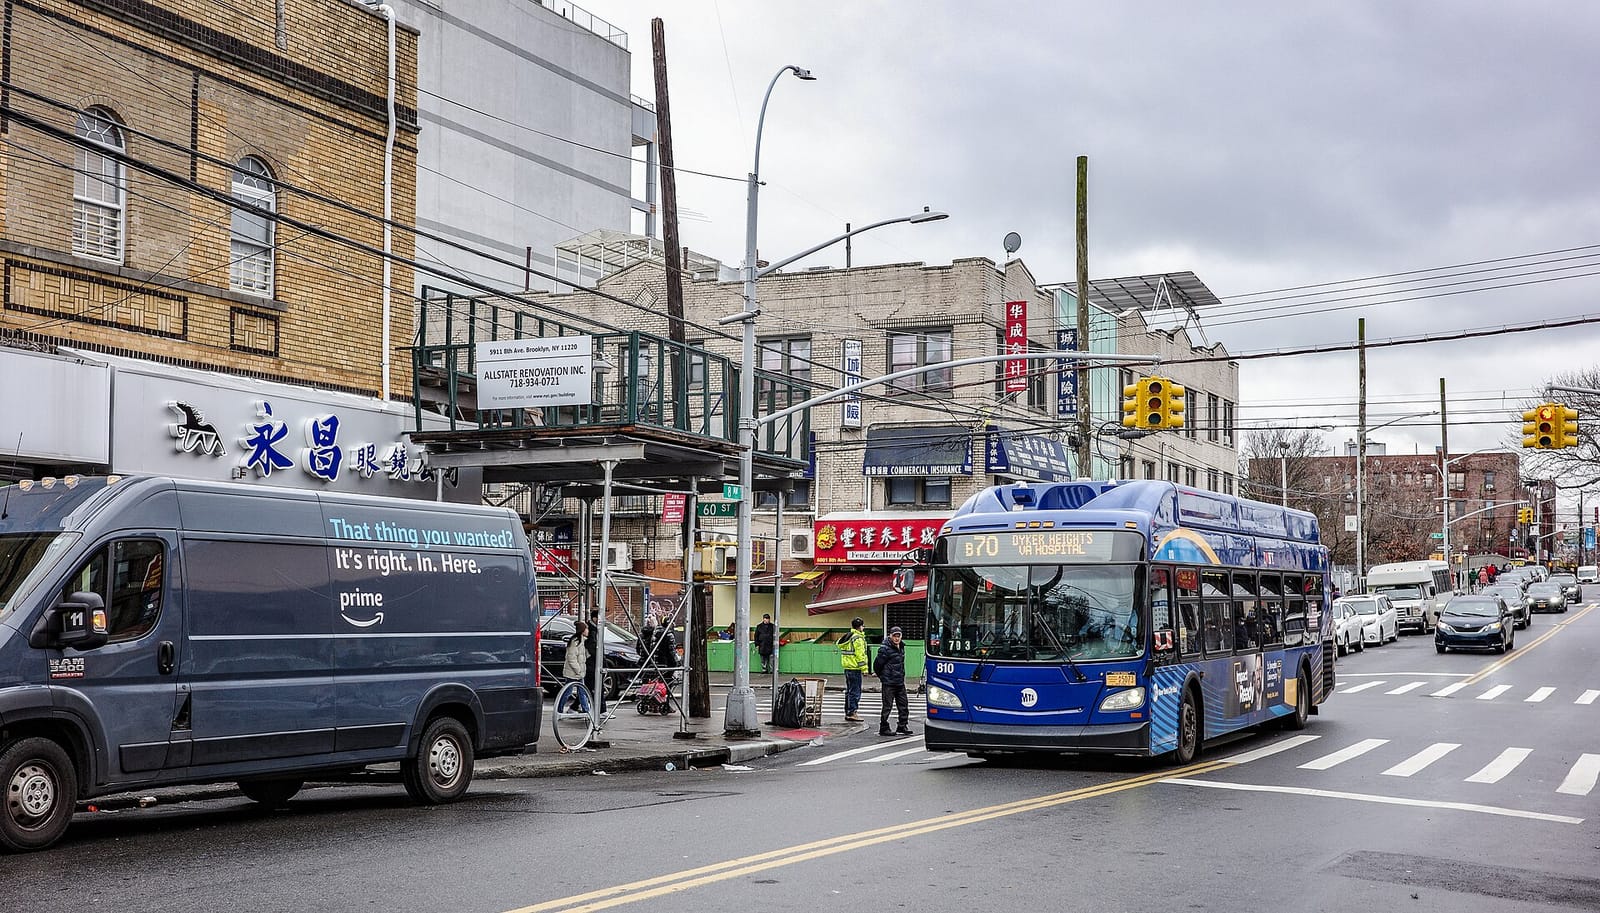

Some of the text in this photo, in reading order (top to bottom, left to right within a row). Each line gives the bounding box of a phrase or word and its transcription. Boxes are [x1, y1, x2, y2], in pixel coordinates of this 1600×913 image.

[489, 348, 503, 356] 5911
[525, 345, 551, 353] Brooklyn,
[560, 343, 578, 351] 11220
[846, 342, 860, 350] CITY
[484, 365, 586, 380] ALLSTATE RENOVATION INC.
[510, 376, 560, 388] 718-934-0721
[890, 465, 929, 475] COMMERCIAL
[930, 464, 962, 474] INSURANCE
[727, 486, 732, 498] 8
[703, 503, 731, 516] 60 ST
[329, 518, 513, 549] That thing you wanted?
[965, 532, 1094, 557] B70 DYKER HEIGHTS
[1018, 544, 1086, 556] VA HOSPITAL
[335, 549, 482, 577] It's right. In. Here.
[339, 587, 384, 611] prime
[70, 611, 83, 626] 11
[49, 657, 85, 666] RAM
[49, 664, 85, 672] 3500
[936, 662, 954, 674] 810
